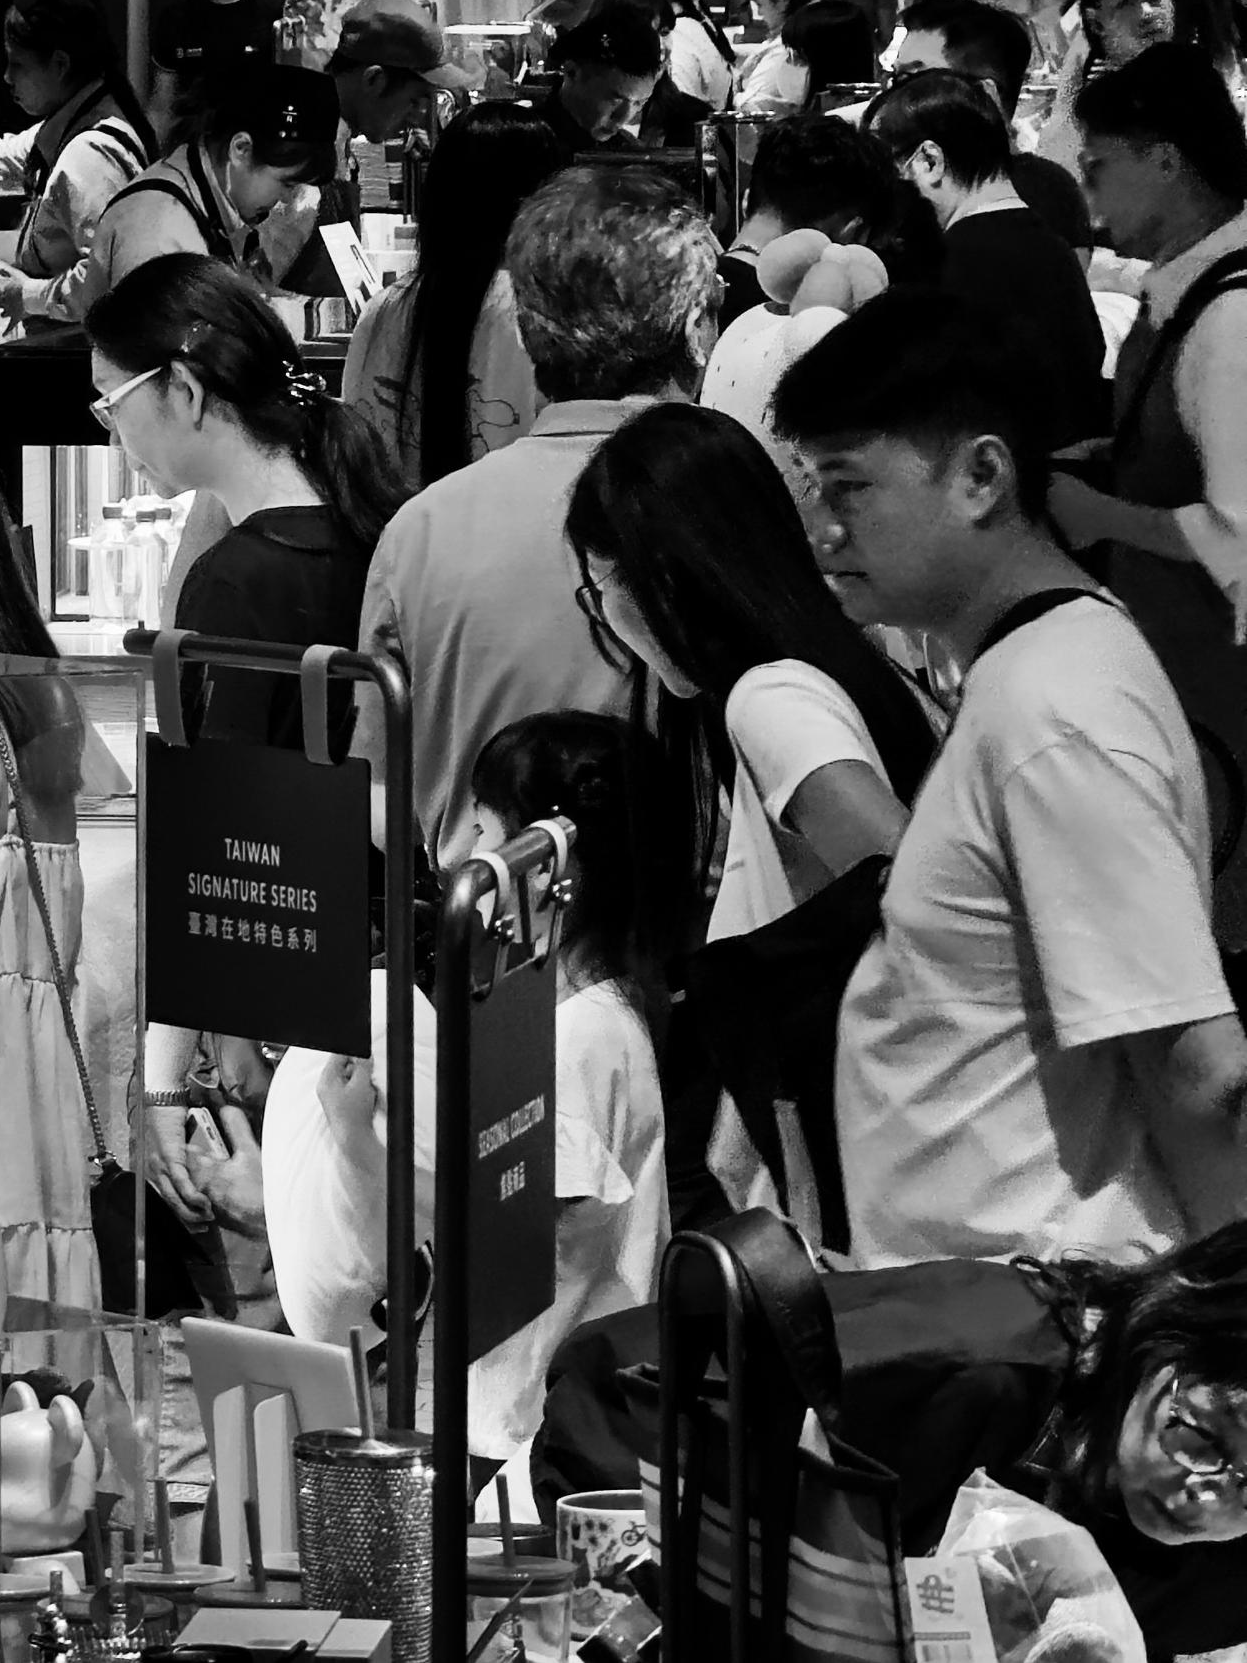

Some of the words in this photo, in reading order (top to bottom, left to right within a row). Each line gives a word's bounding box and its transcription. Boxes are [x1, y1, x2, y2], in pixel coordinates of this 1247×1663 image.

[224, 838, 281, 868] TAIWAN
[187, 872, 267, 905] SIGNATURE
[271, 884, 317, 913] SERIES
[188, 911, 317, 953] 臺灣在地特色系列
